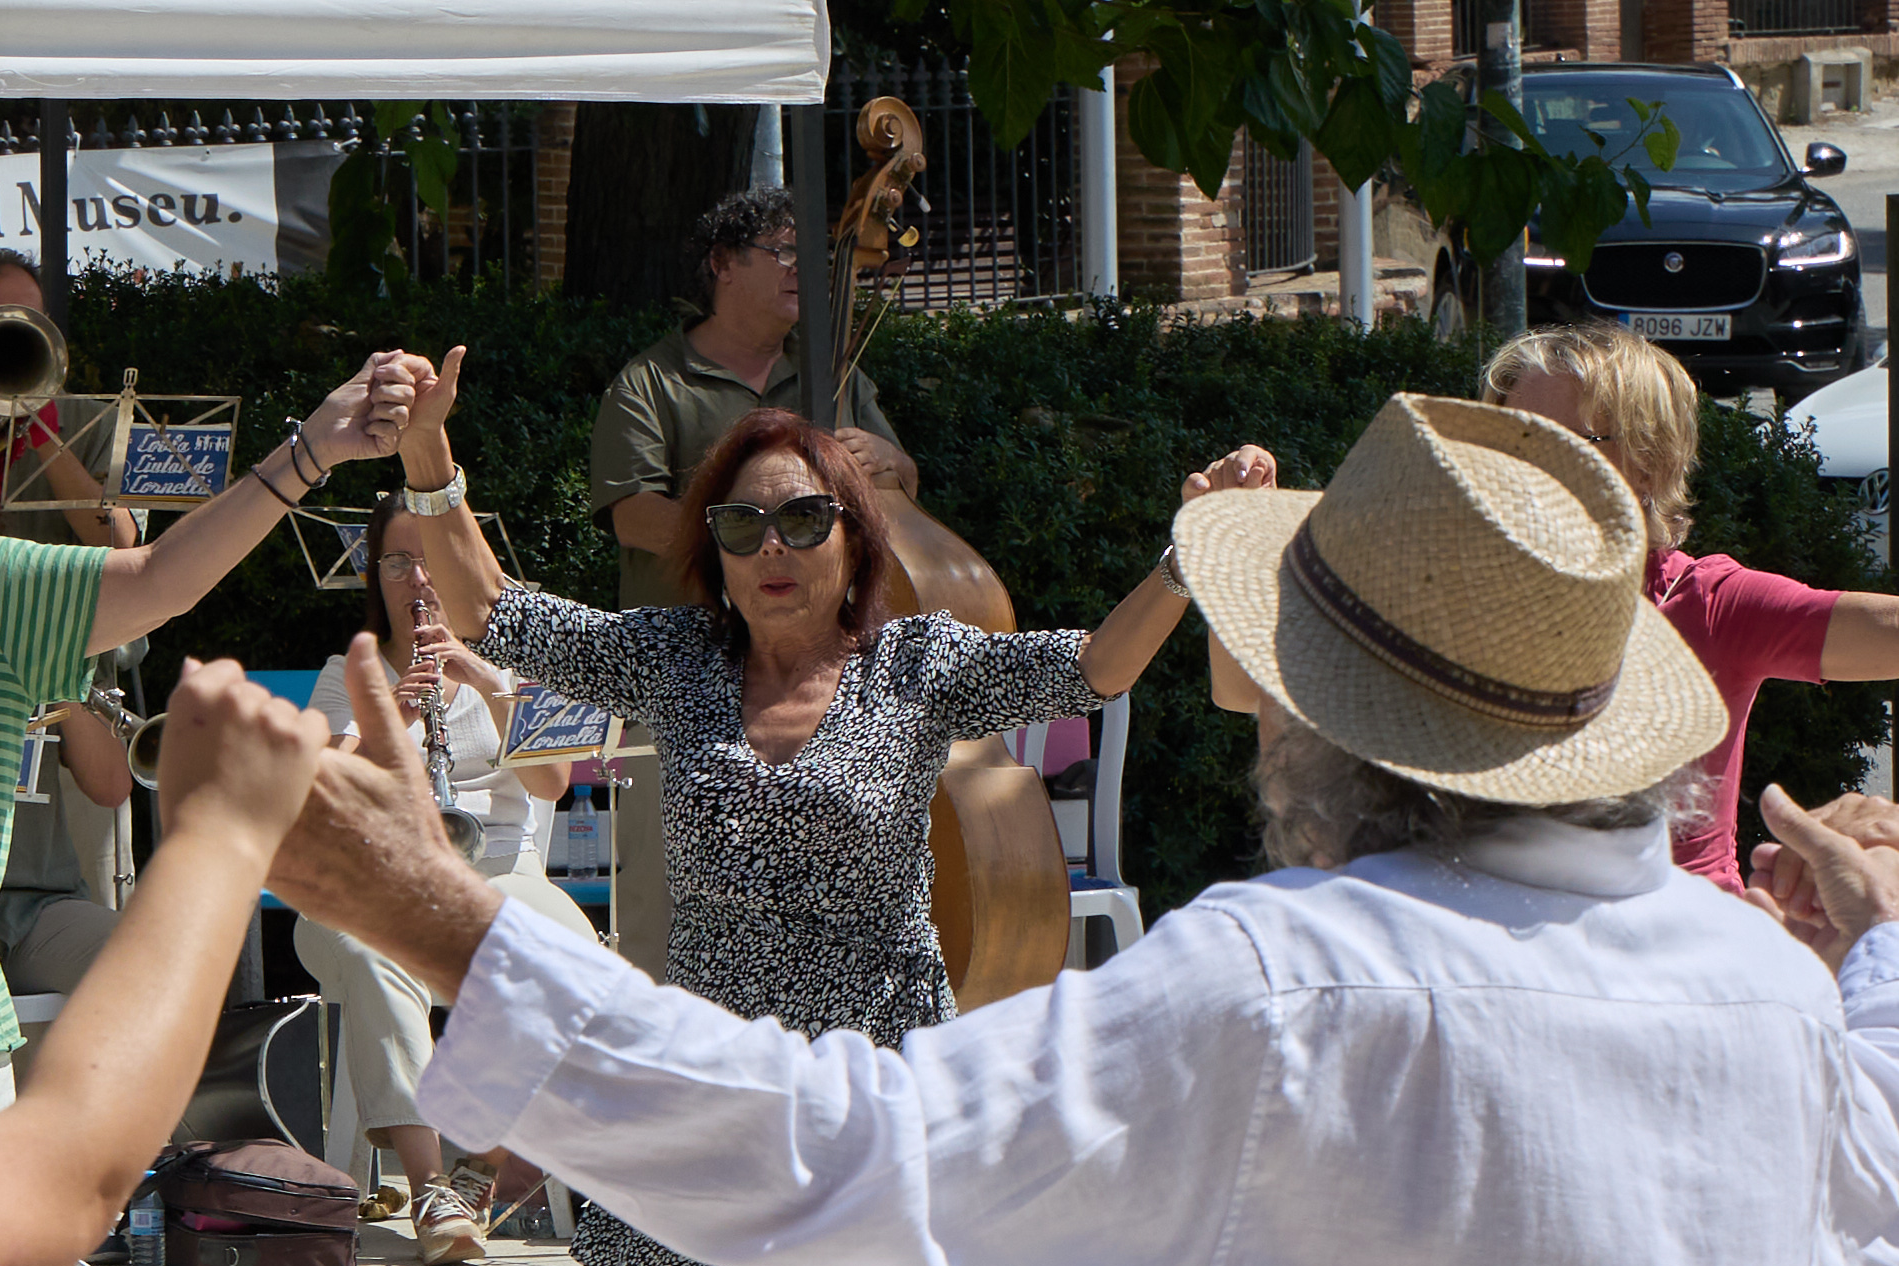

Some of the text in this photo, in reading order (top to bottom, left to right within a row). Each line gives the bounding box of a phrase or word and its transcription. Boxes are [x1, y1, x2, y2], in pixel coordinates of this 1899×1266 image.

[1634, 317, 1726, 337] 8096 JZW
[192, 455, 215, 475] de
